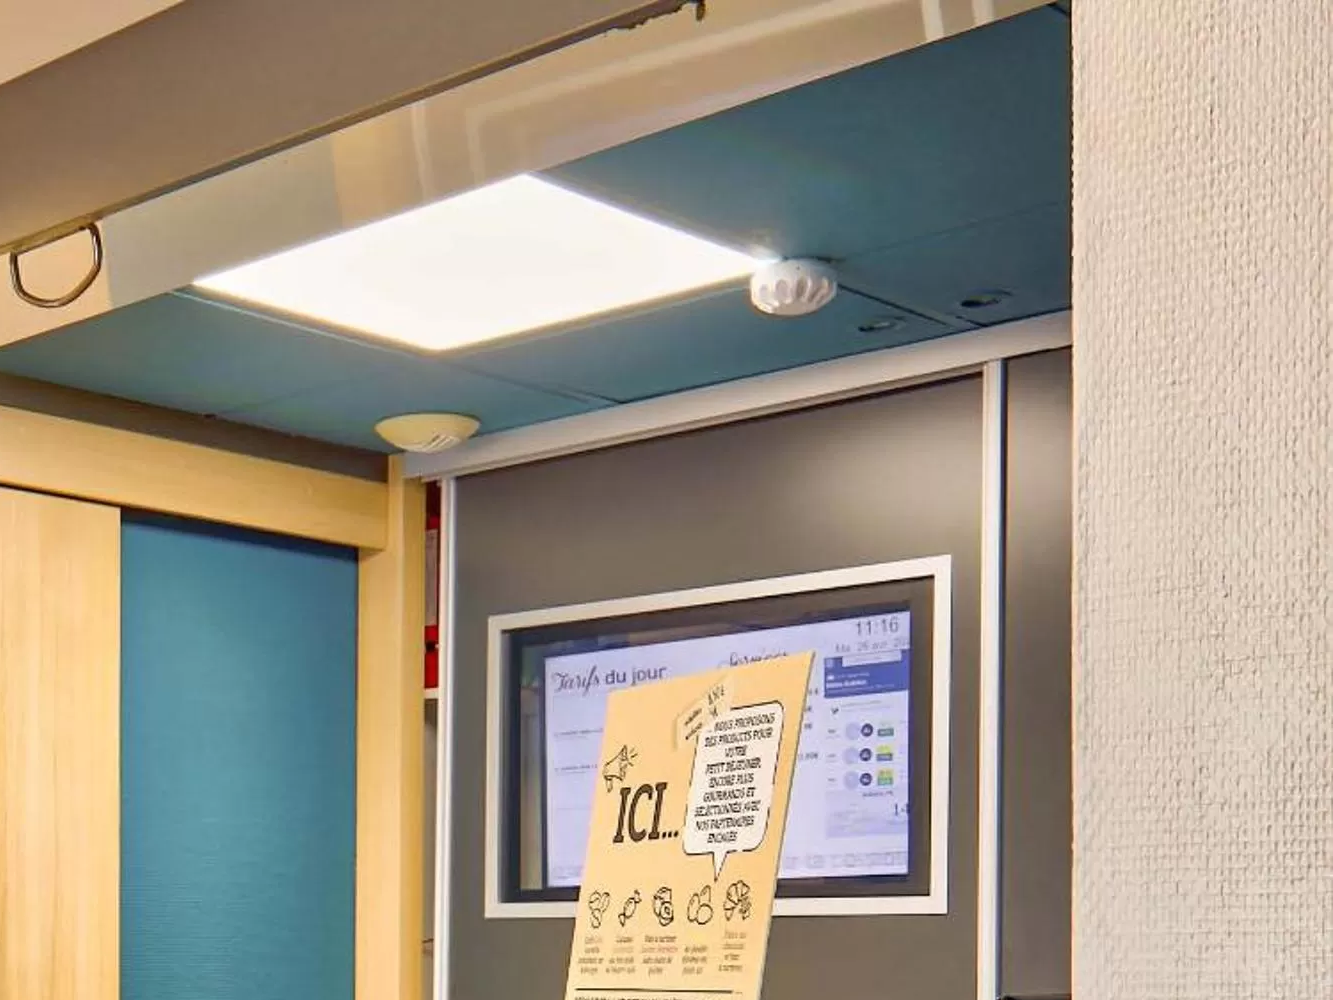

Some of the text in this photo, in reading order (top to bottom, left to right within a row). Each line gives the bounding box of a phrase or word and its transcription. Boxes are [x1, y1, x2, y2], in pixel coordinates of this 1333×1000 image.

[856, 615, 900, 636] 11:16
[551, 664, 668, 696] Tarifs du jour
